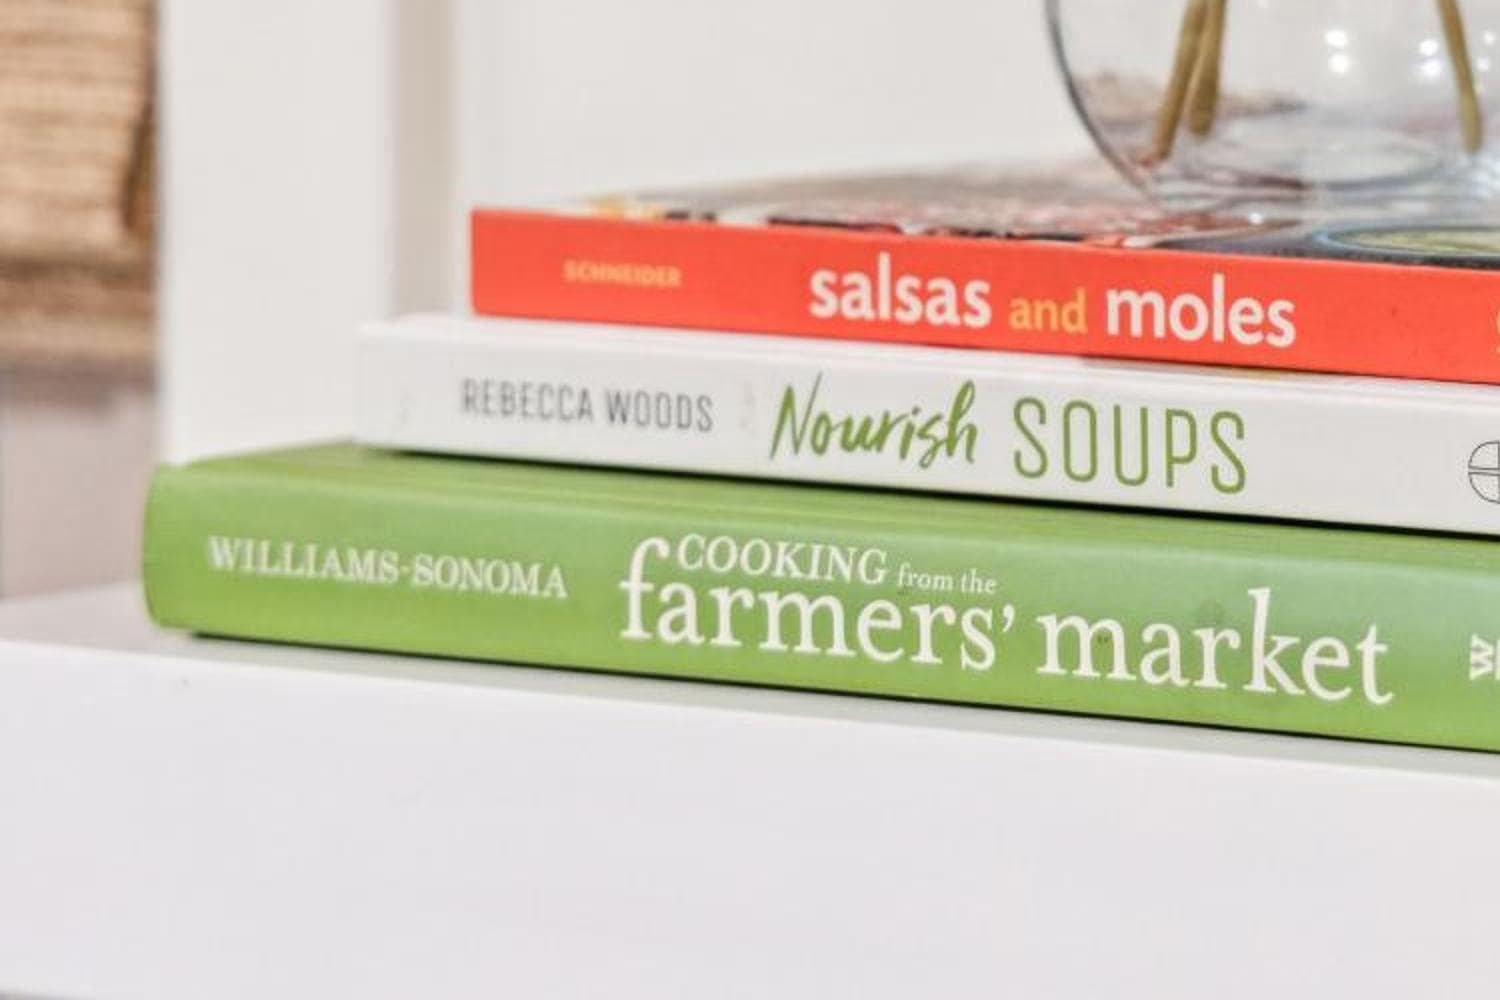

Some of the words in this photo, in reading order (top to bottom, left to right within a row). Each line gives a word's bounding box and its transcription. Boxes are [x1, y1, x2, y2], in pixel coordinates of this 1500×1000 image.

[563, 260, 682, 287] SCHNEIDER
[809, 252, 992, 327] salsas
[1009, 288, 1087, 334] and
[1106, 274, 1296, 348] moles
[463, 378, 594, 423] REBECCA
[607, 390, 714, 432] WOODS
[770, 373, 977, 468] Nourish
[1014, 398, 1246, 494] SOUPS
[208, 535, 568, 599] WILLIAMS-SONOMA
[677, 534, 889, 585] COOKING
[897, 562, 954, 593] from
[960, 567, 998, 595] the
[619, 536, 1014, 671] farmers'
[1036, 587, 1394, 704] market
